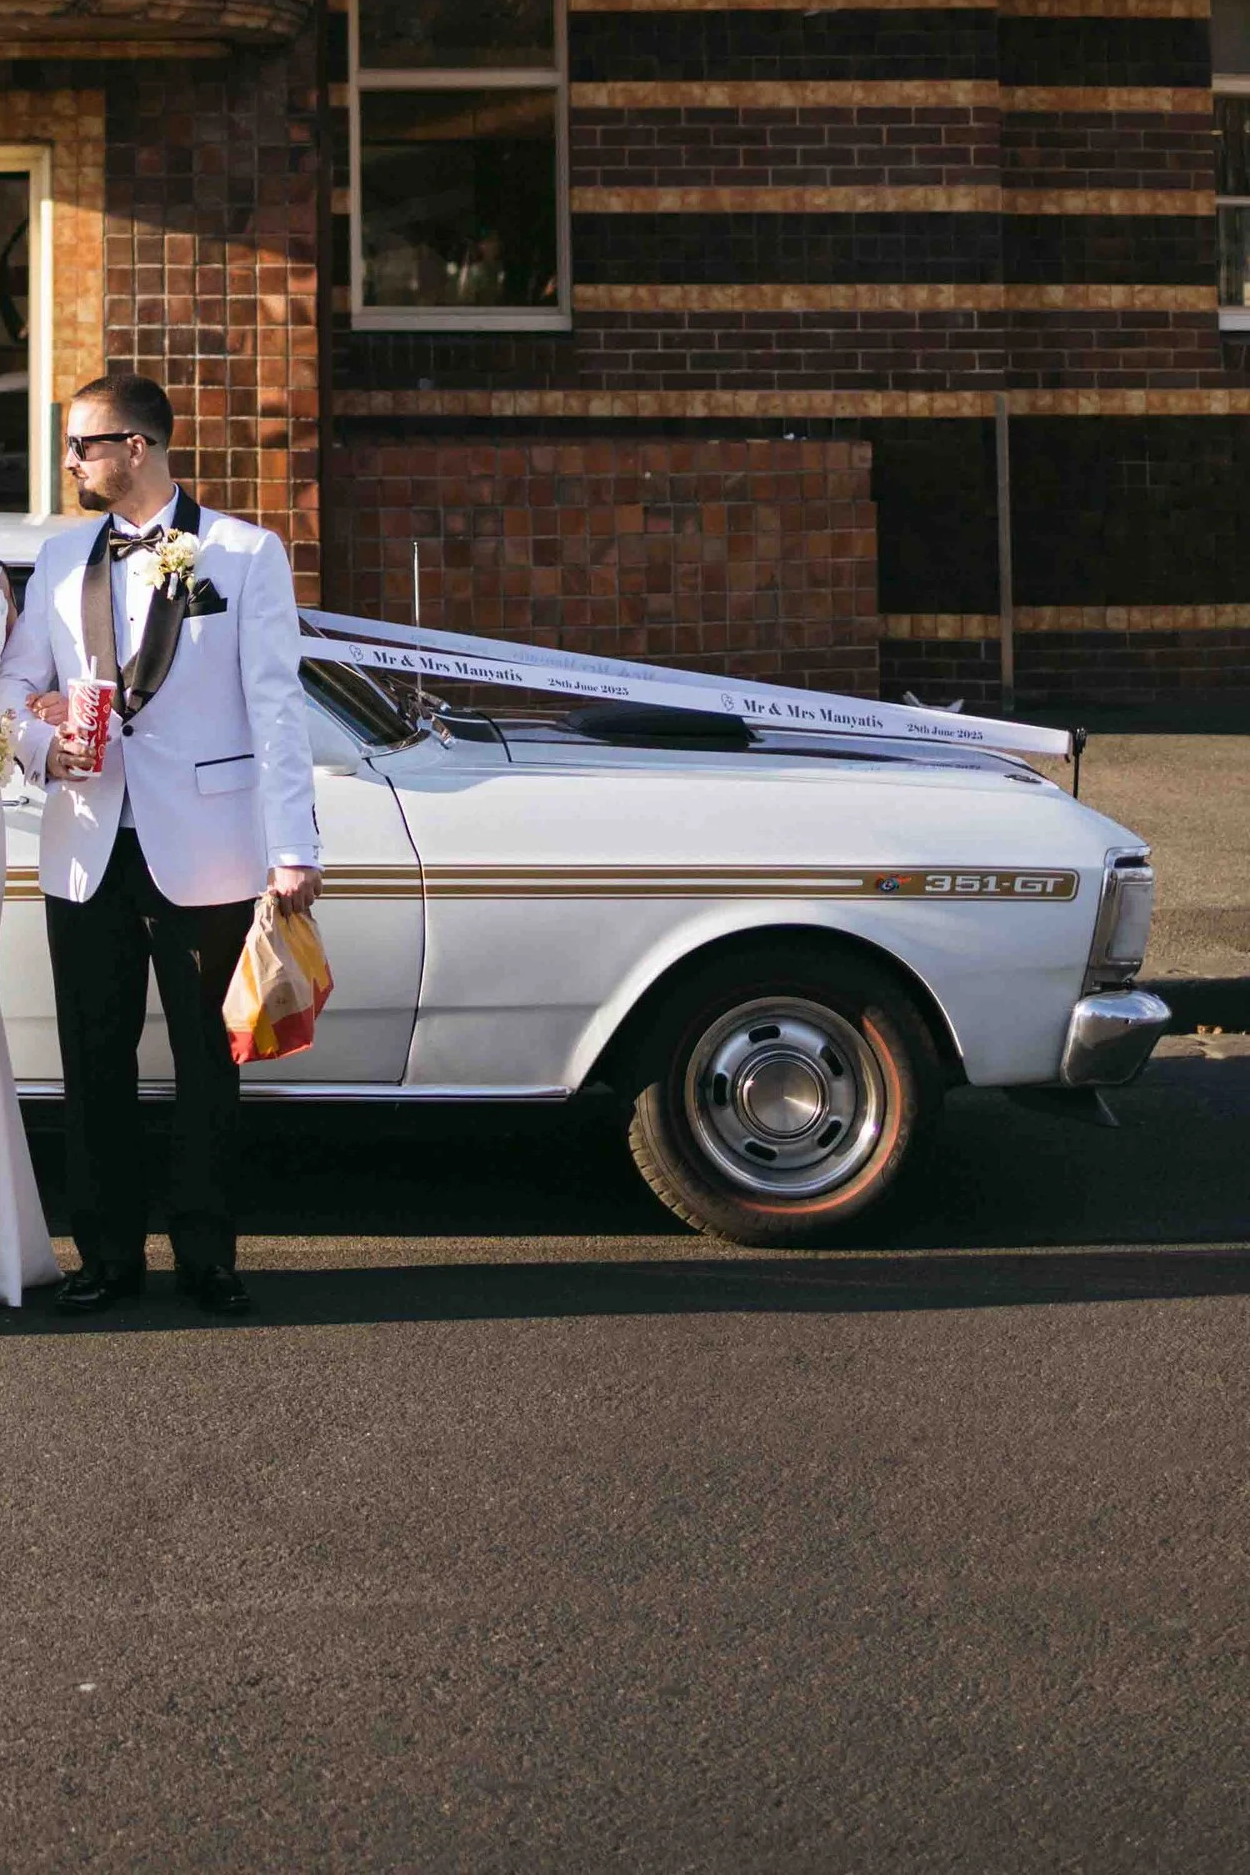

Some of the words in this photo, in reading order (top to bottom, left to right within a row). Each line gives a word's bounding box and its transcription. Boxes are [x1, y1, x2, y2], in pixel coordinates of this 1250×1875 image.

[373, 651, 397, 665] Mr
[401, 654, 416, 667] &
[419, 656, 450, 673] Mrs
[454, 661, 523, 681] Manyatis
[547, 677, 572, 689] 28th
[574, 681, 599, 692] June
[600, 685, 630, 696] 2025
[743, 699, 765, 714] Mr
[769, 702, 782, 716] &
[786, 704, 816, 720] Mrs
[819, 708, 884, 729] Manyatis
[906, 723, 930, 735] 28th
[931, 726, 955, 737] June
[956, 729, 984, 740] 2025
